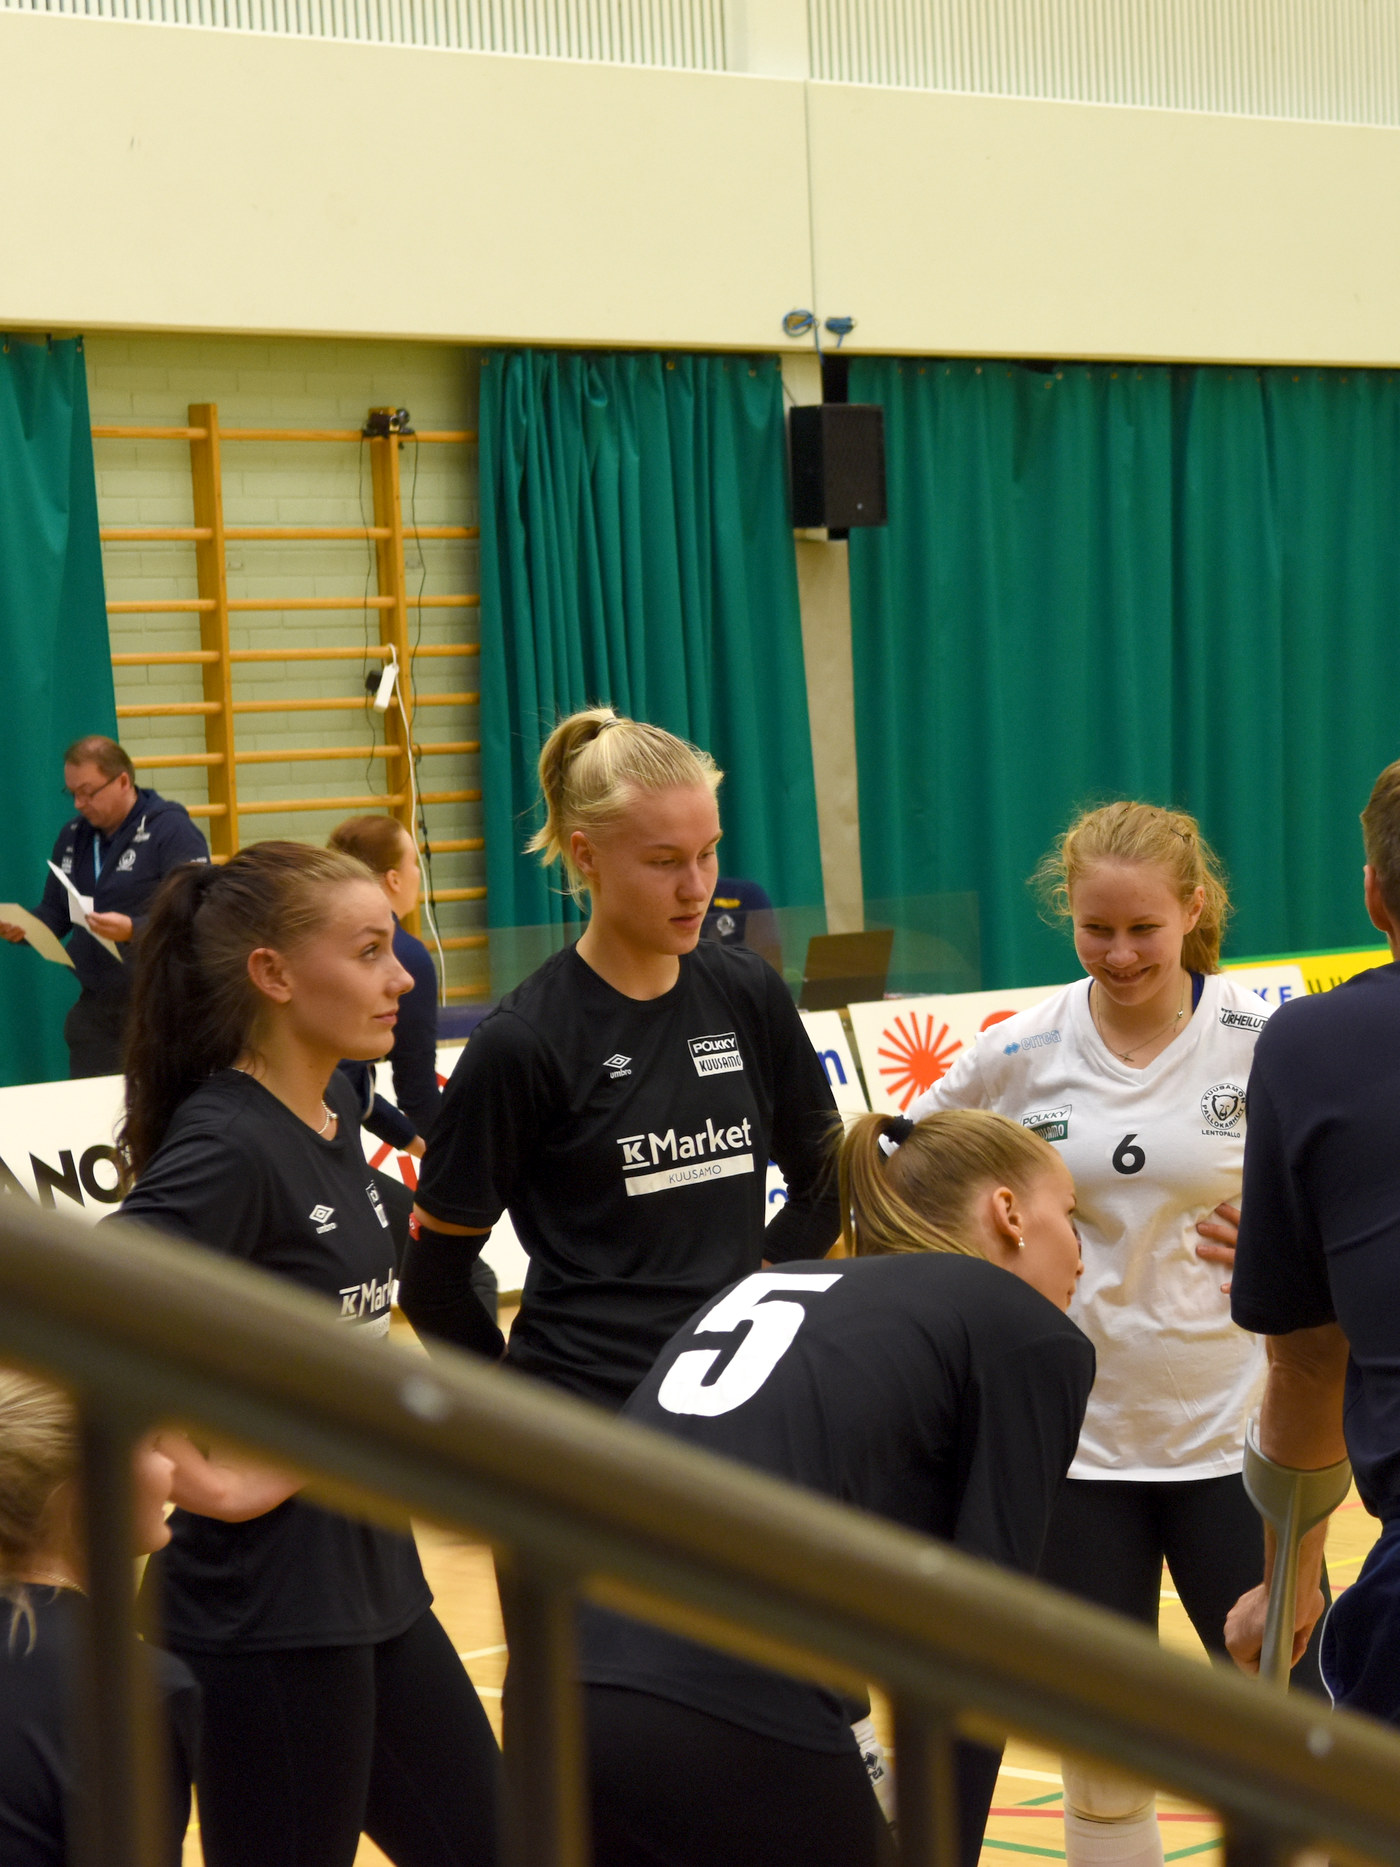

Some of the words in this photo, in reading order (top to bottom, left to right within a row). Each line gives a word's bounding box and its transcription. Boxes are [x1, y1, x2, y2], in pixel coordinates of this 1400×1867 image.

[698, 1054, 742, 1072] KUUSAMO
[610, 1068, 632, 1079] umbro
[648, 1117, 752, 1165] Market
[1201, 1129, 1241, 1139] LENTOPALLO
[1112, 1133, 1146, 1175] 6
[668, 1164, 722, 1184] KUUSAMO
[657, 1272, 844, 1417] 5
